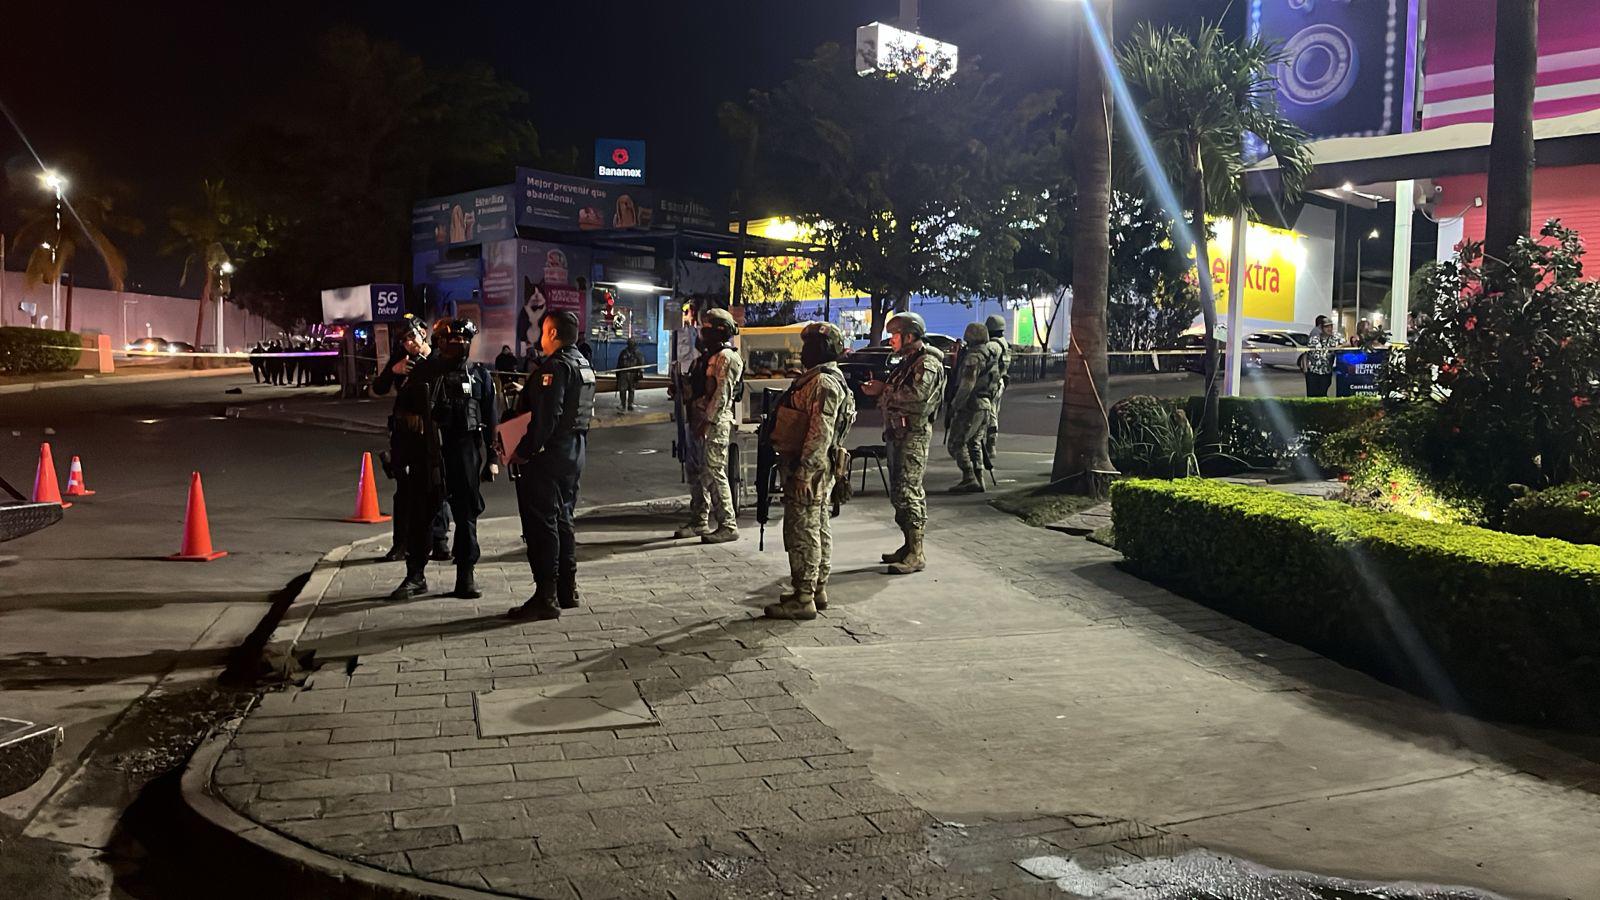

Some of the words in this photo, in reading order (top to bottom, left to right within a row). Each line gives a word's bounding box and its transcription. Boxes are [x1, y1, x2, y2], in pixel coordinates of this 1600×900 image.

[599, 165, 642, 178] Banamex
[526, 176, 552, 190] Mejor
[553, 181, 590, 196] prevenir
[591, 189, 607, 199] que
[1212, 257, 1280, 294] elktra
[377, 291, 398, 307] 5G
